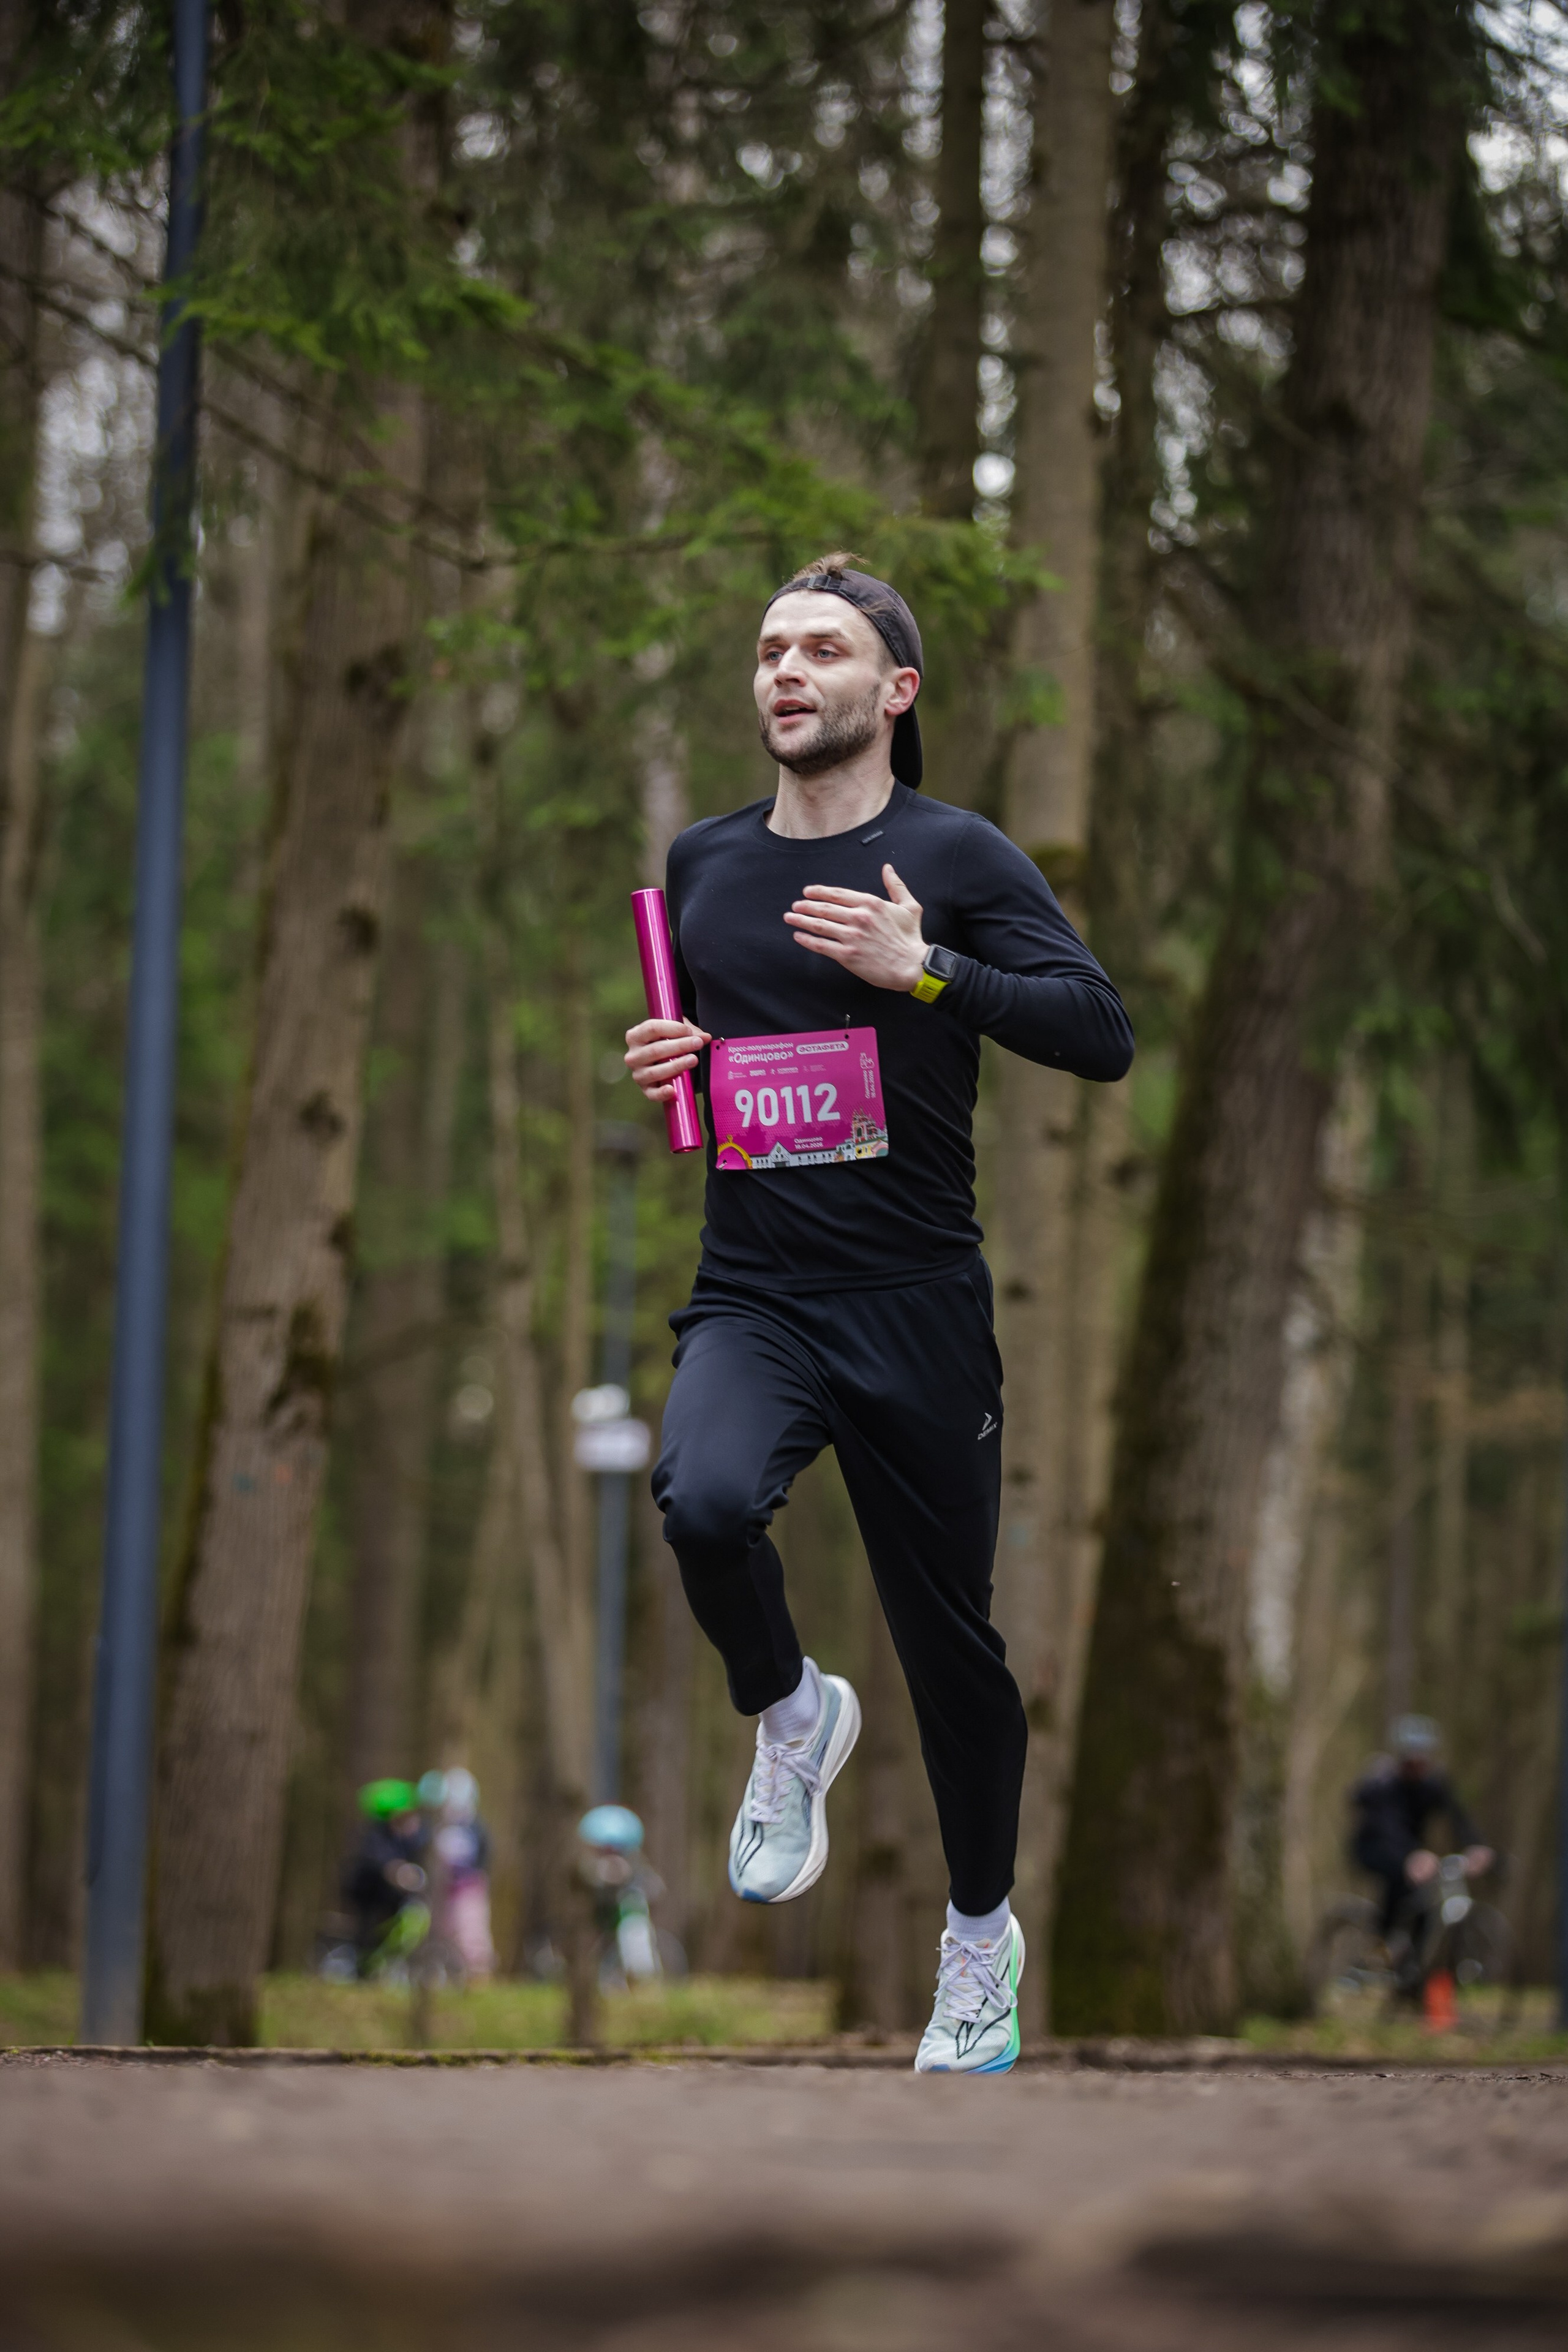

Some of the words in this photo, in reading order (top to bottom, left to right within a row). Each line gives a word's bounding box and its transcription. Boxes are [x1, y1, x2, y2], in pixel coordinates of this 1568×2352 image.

[799, 1043, 846, 1052] ЭСТАФЕТА
[728, 1050, 794, 1065] «Одинцово»
[735, 1083, 840, 1128] 90112
